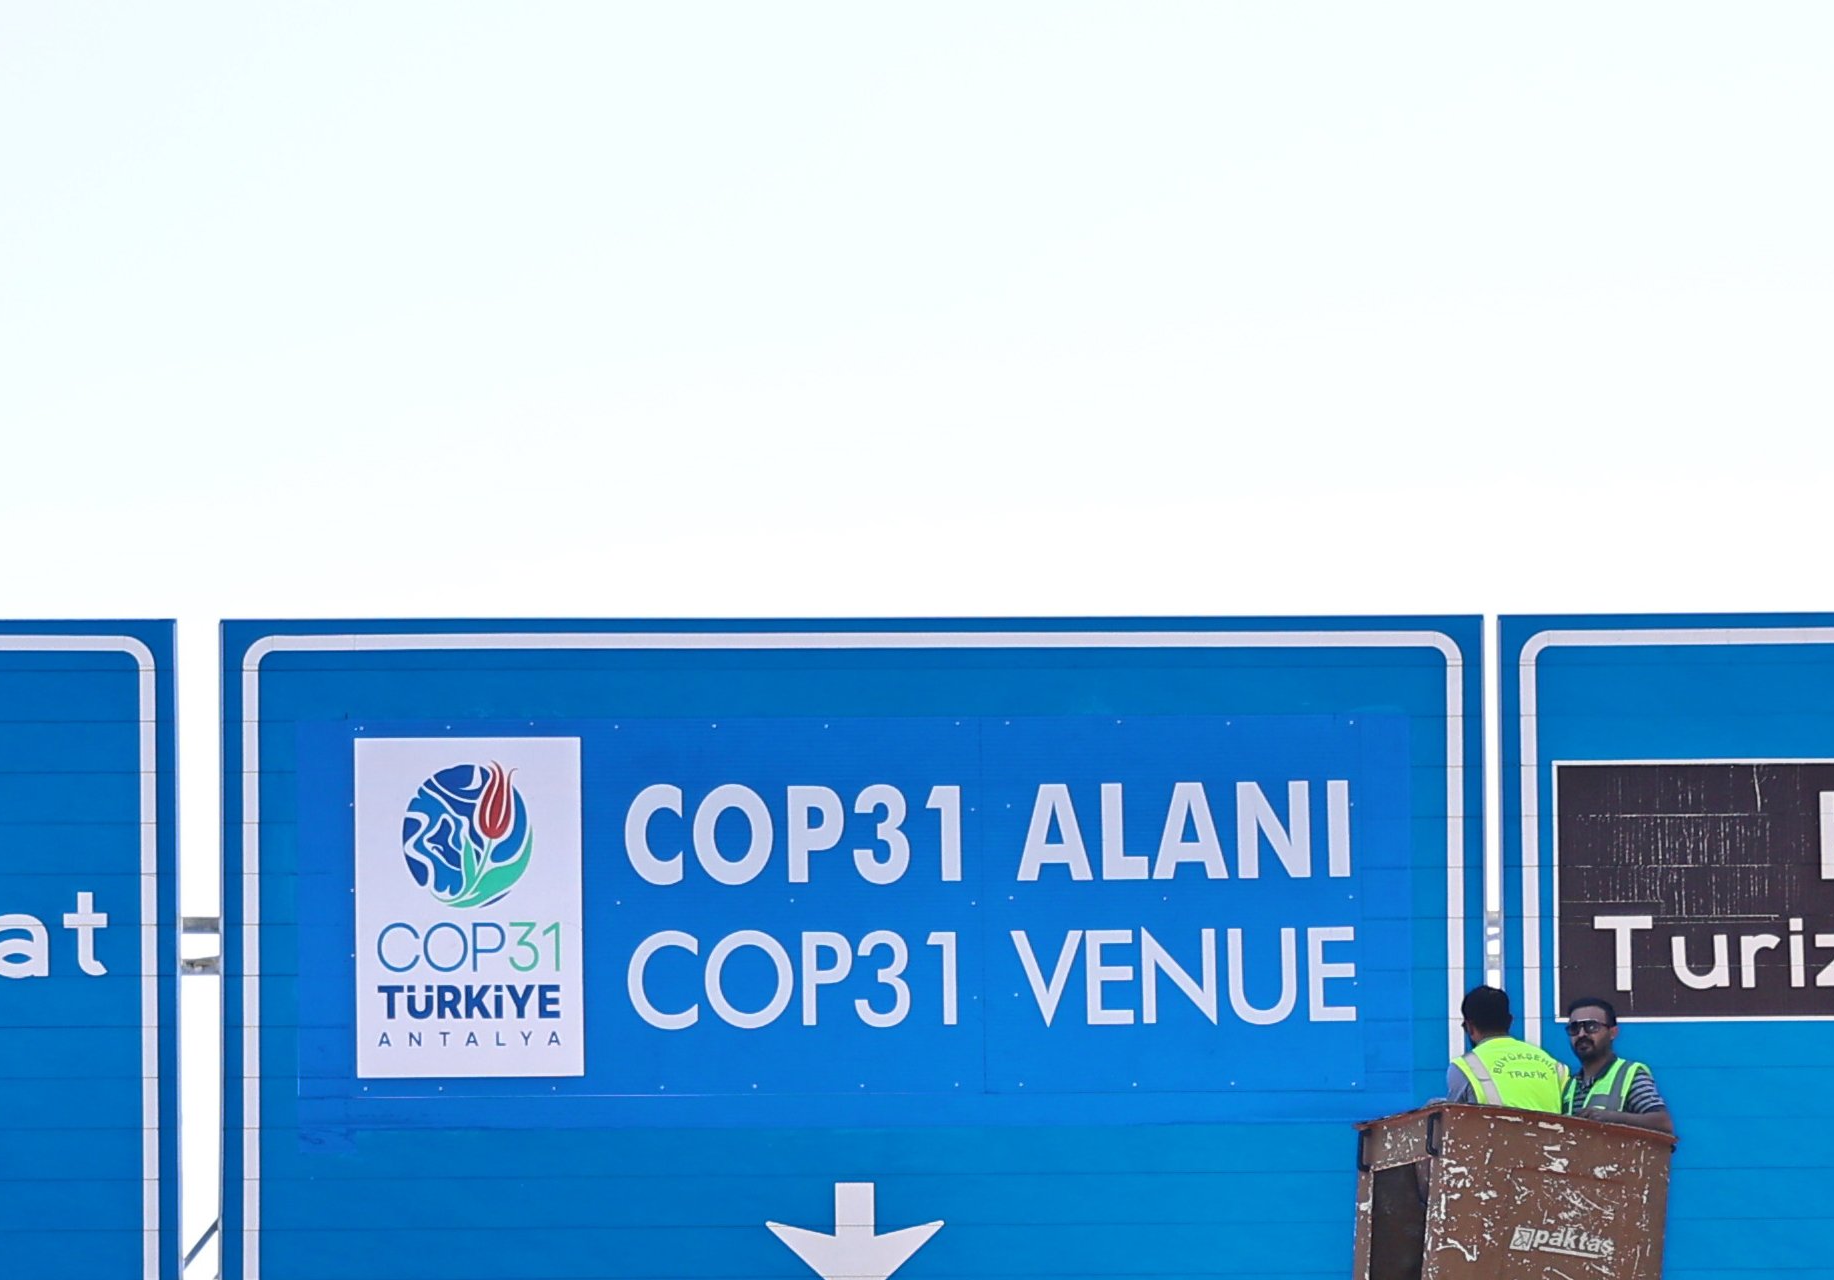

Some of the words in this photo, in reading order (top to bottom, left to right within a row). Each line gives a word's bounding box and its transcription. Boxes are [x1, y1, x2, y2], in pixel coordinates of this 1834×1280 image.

[624, 783, 962, 885] COP31
[1016, 779, 1351, 881] ALANI
[377, 921, 561, 973] COP31
[627, 929, 958, 1029] COP31
[1010, 926, 1357, 1028] VENUE
[378, 1031, 561, 1047] ANTALYA
[1507, 1070, 1548, 1081] TRAFİK
